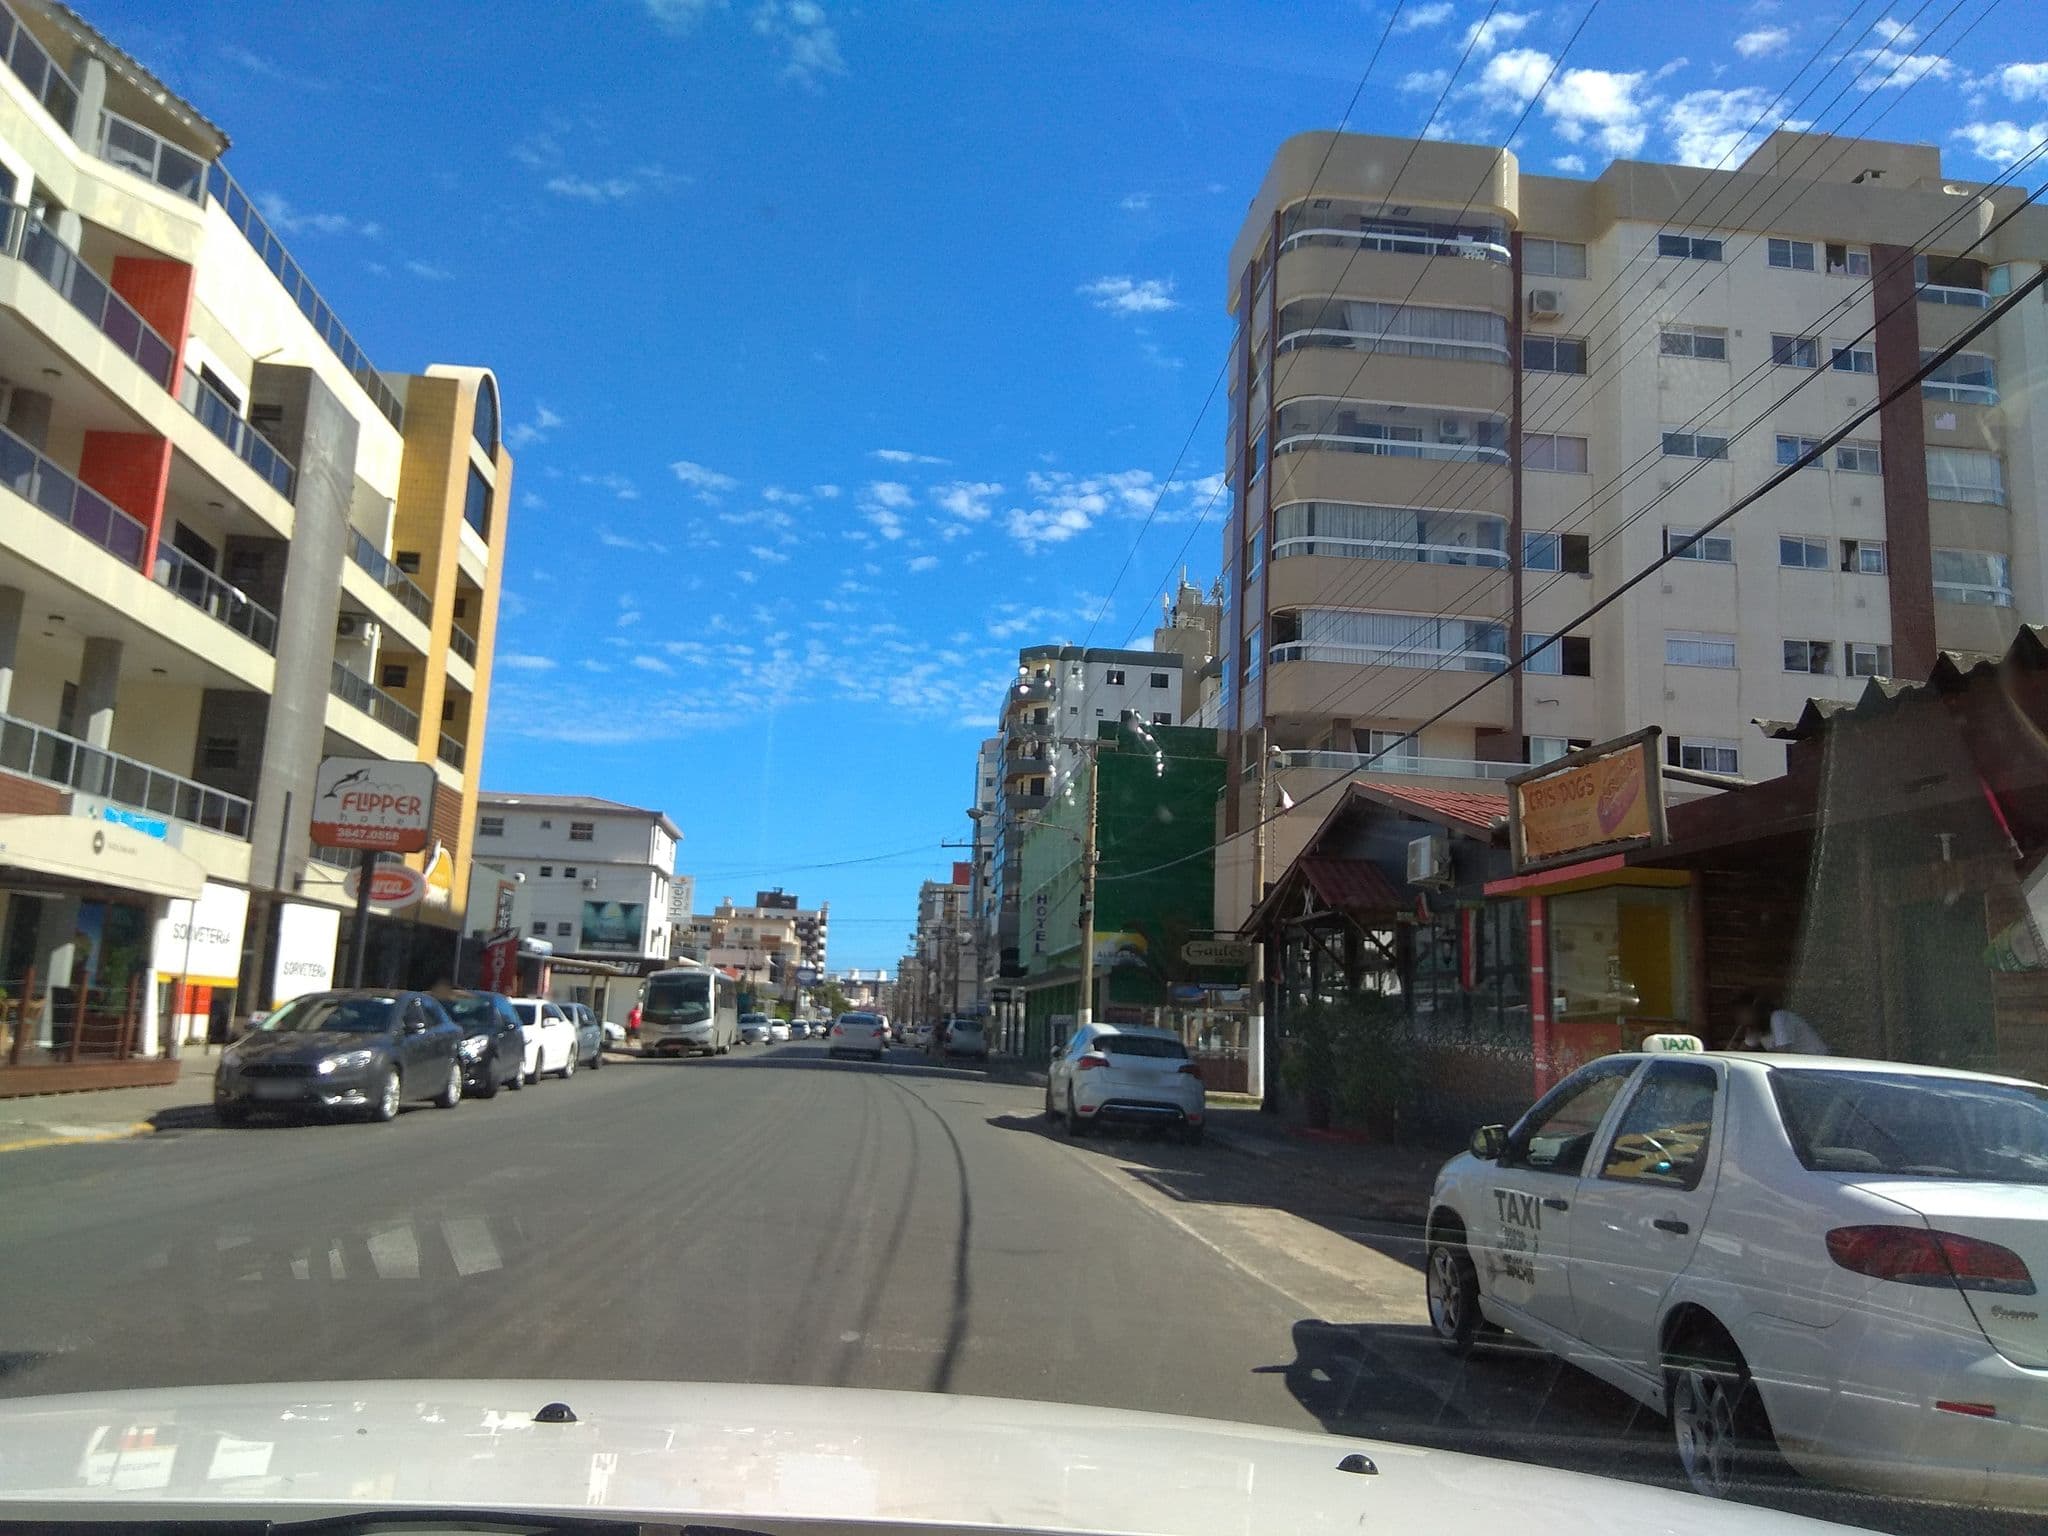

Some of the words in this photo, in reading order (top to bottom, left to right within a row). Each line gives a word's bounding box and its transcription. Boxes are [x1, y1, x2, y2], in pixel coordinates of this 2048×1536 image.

[341, 791, 422, 816] FLIPPER
[1558, 773, 1595, 805] DOGS
[340, 811, 421, 826] hotel
[669, 885, 684, 917] Hotel
[1035, 894, 1048, 953] HOTEL
[1658, 1037, 1695, 1051] TAXI
[1494, 1189, 1541, 1230] TAXI
